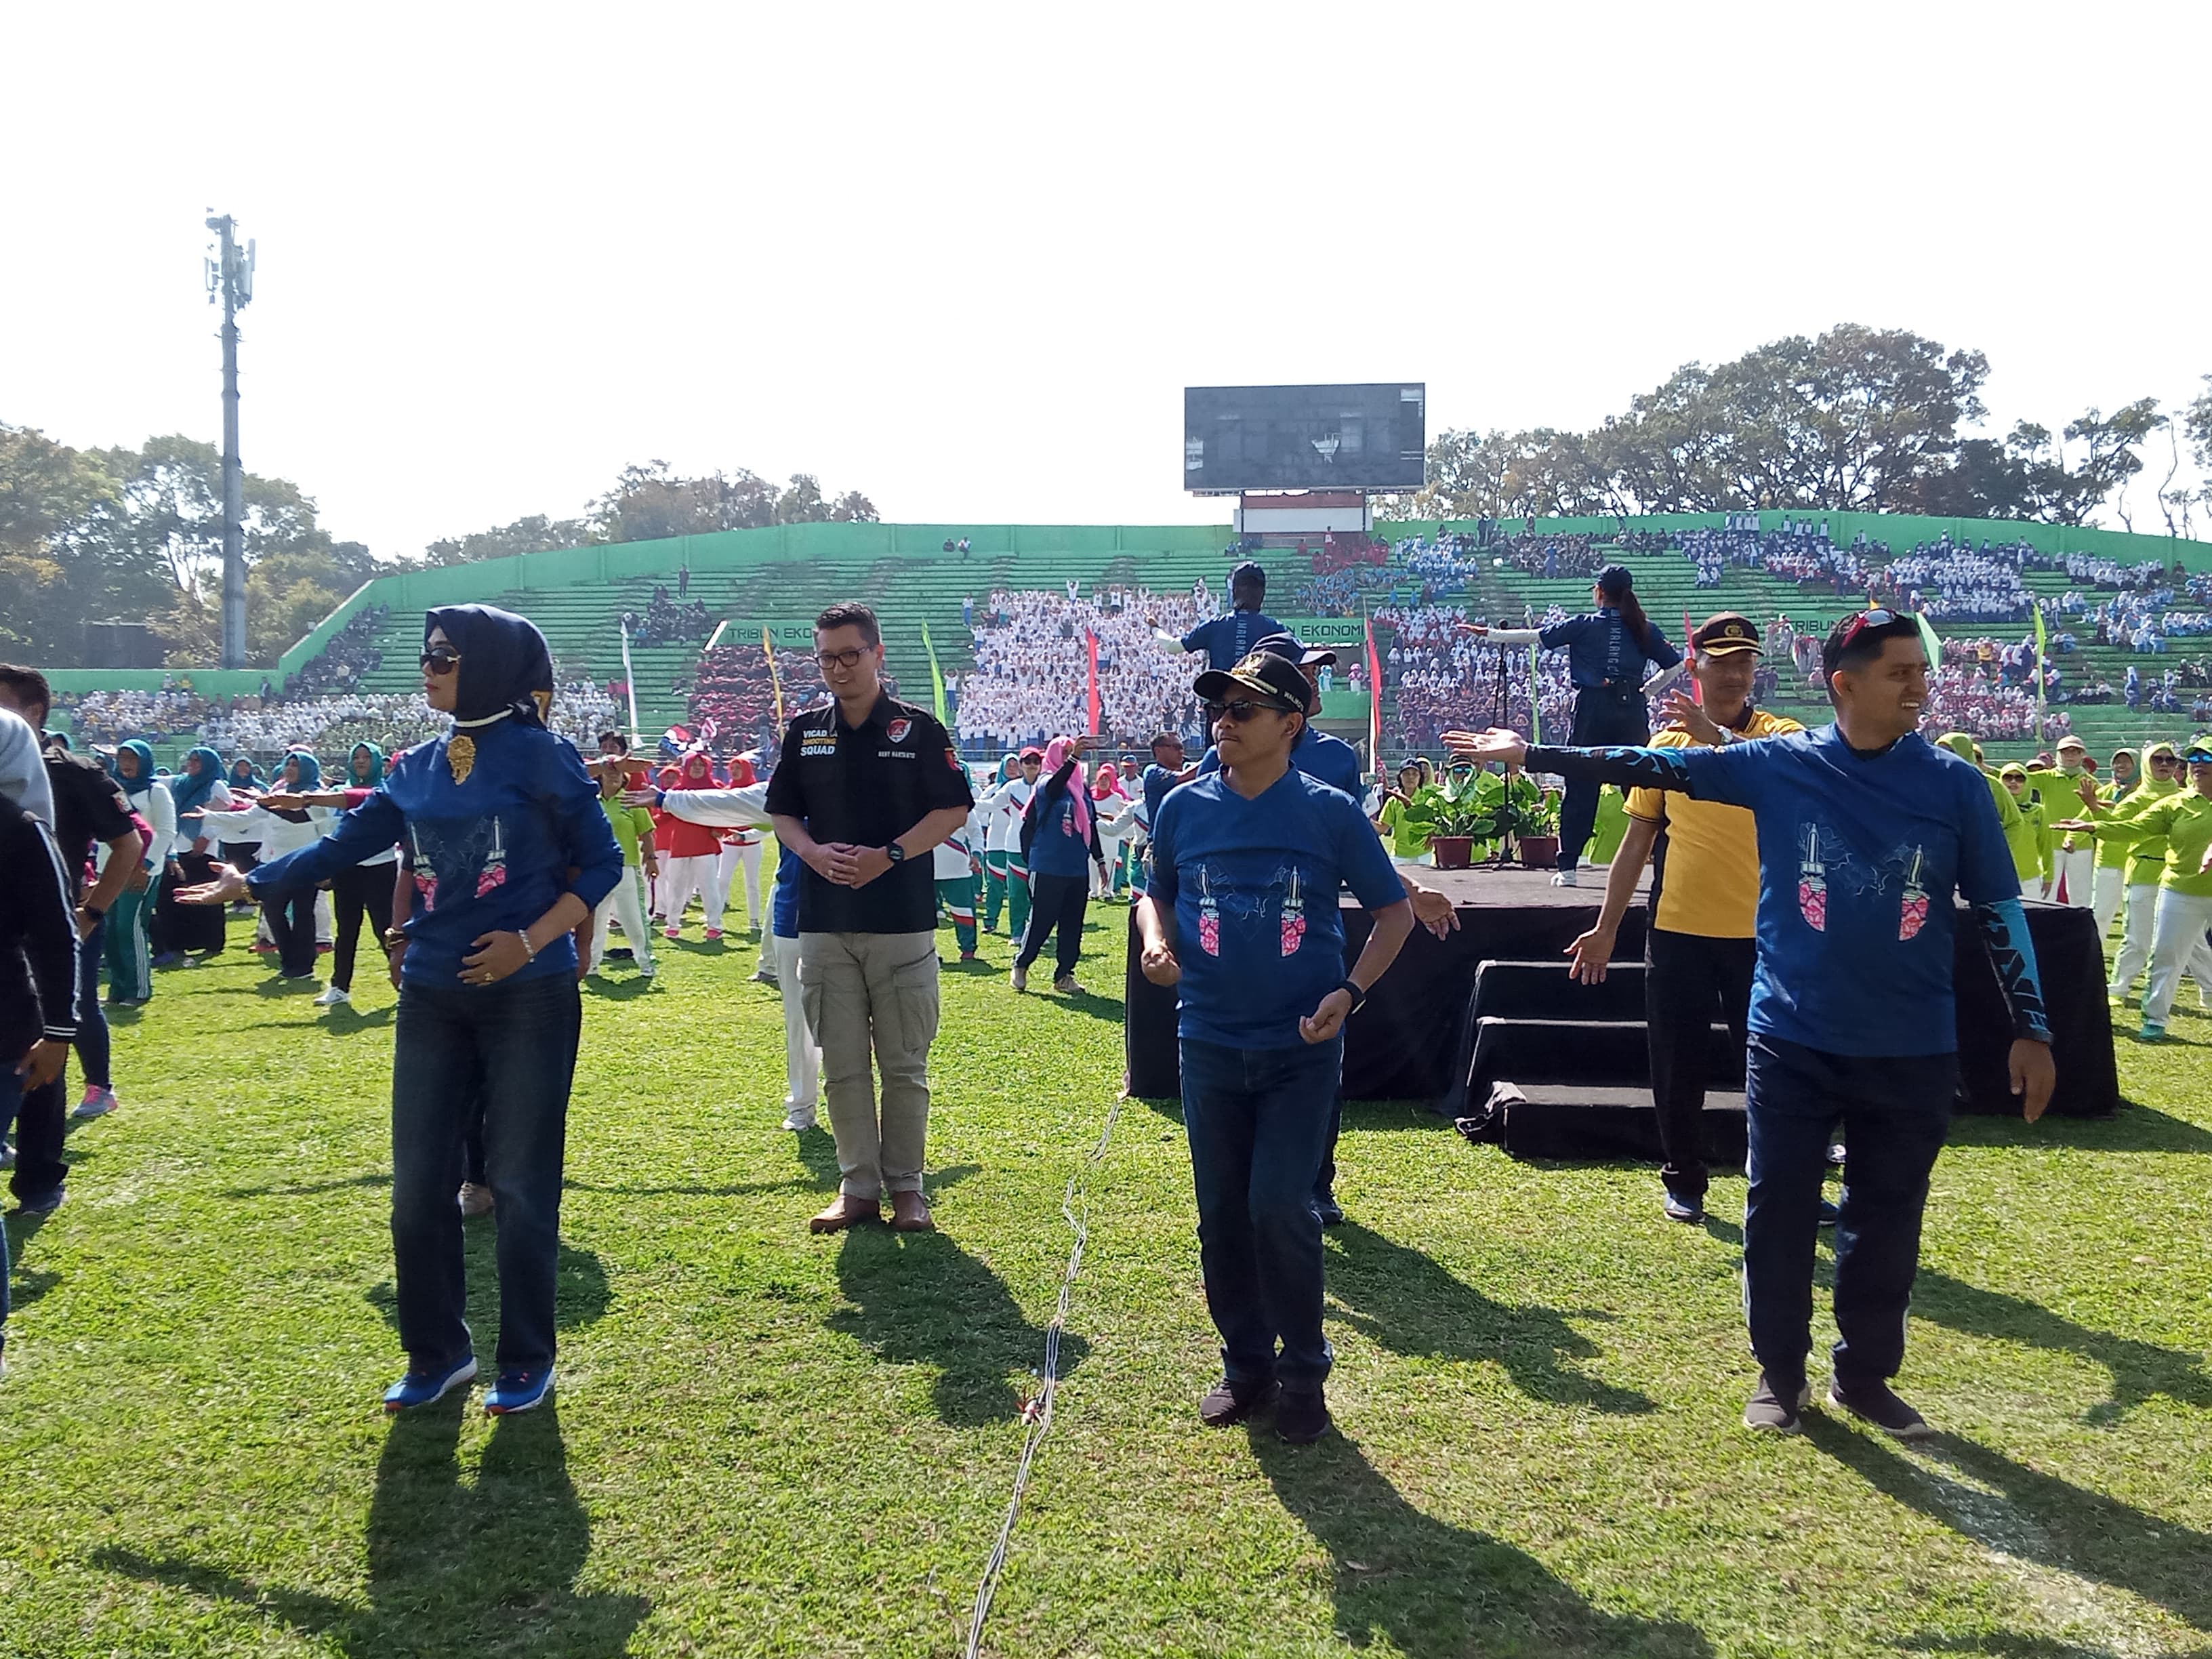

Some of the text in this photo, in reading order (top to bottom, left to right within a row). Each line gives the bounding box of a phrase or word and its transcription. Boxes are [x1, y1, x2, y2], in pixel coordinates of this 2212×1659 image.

[783, 628, 813, 639] EKO
[1301, 625, 1364, 636] EKONOMI
[1607, 628, 1621, 663] MALANG
[803, 729, 838, 738] VICADA
[800, 745, 836, 756] SQUAD
